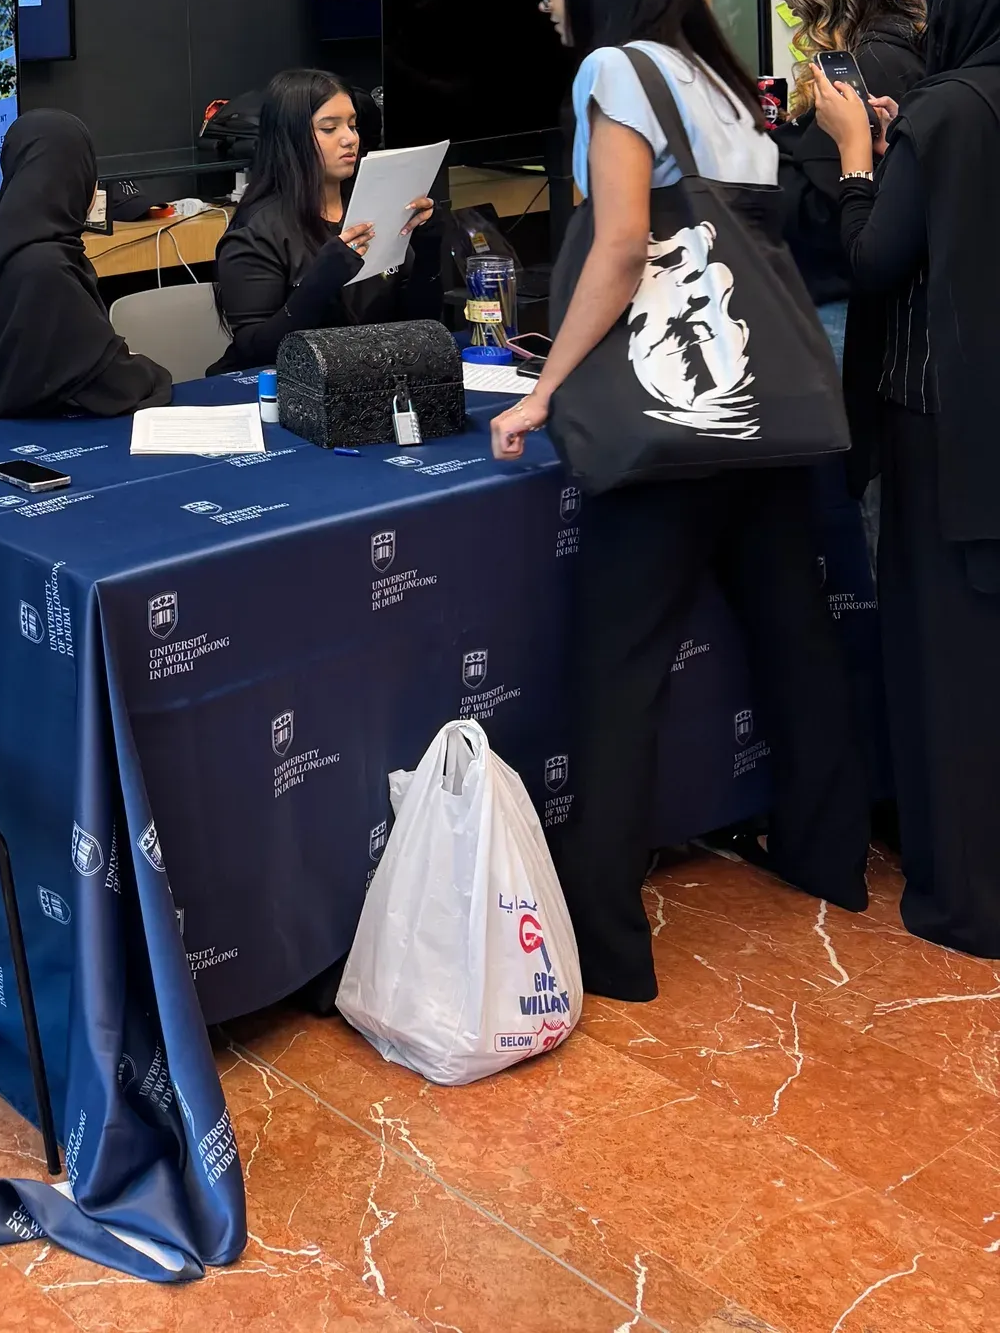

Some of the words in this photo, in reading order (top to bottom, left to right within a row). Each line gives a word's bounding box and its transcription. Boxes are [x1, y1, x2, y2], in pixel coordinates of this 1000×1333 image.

[371, 569, 418, 591] UNIVERSITY
[371, 591, 382, 601] OF
[383, 575, 437, 598] WOLLONGONG
[51, 560, 66, 639] WOLLONGONG
[371, 601, 381, 611] IN
[381, 592, 403, 609] DUBAI
[45, 580, 57, 651] UNIVERSITY
[63, 606, 73, 643] DUBAI
[58, 639, 66, 654] OF
[66, 644, 75, 658] IN
[149, 633, 208, 659] UNIVERSITY
[149, 657, 163, 670] OF
[164, 636, 231, 667] WOLLONGONG
[149, 669, 162, 680] IN
[163, 661, 194, 678] DUBAI
[460, 684, 506, 706] UNIVERSITY
[460, 703, 472, 715] OF
[472, 687, 521, 713] WOLLONGONG
[469, 708, 494, 721] DUBAI
[273, 748, 320, 778] UNIVERSITY
[273, 775, 283, 788] OF
[282, 752, 340, 783] WOLLONGONG
[273, 786, 283, 798] IN
[282, 774, 304, 793] DUBAI
[186, 947, 216, 963] RSITY
[191, 948, 239, 971] LONGONG
[519, 990, 570, 1016] VILLA
[500, 1036, 533, 1047] BELOW
[5, 1217, 20, 1233] IN
[12, 1210, 28, 1225] OF
